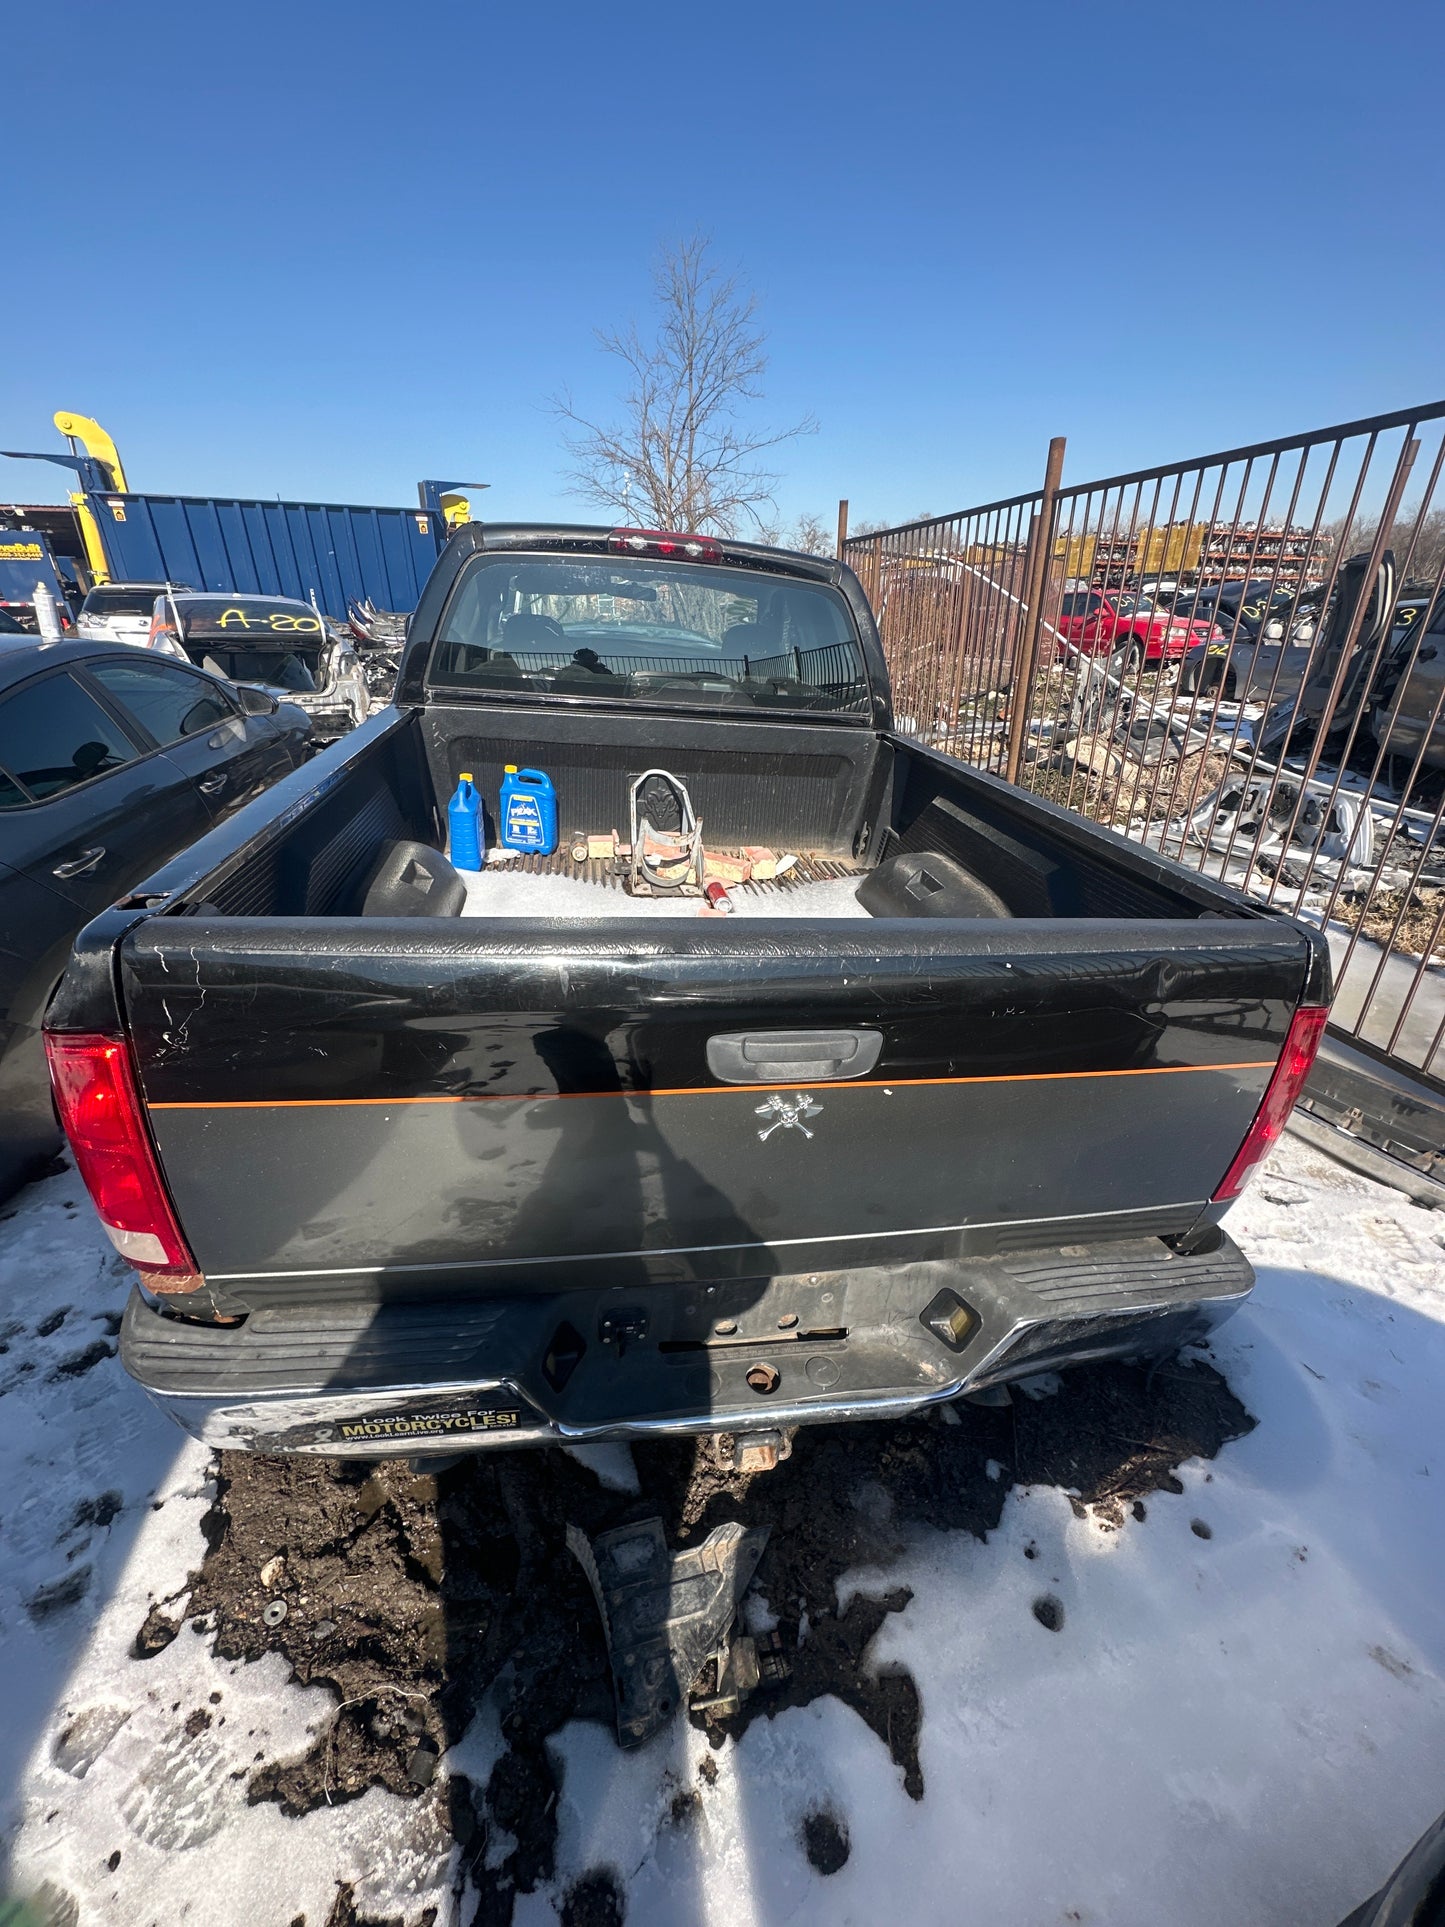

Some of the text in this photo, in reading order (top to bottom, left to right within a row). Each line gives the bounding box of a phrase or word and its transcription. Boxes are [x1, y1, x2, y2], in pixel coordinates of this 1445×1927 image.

[216, 609, 320, 632] A-20
[1396, 608, 1417, 626] 3
[341, 1413, 518, 1437] MOTORCYCLES!
[362, 1409, 496, 1424] Look Twice For
